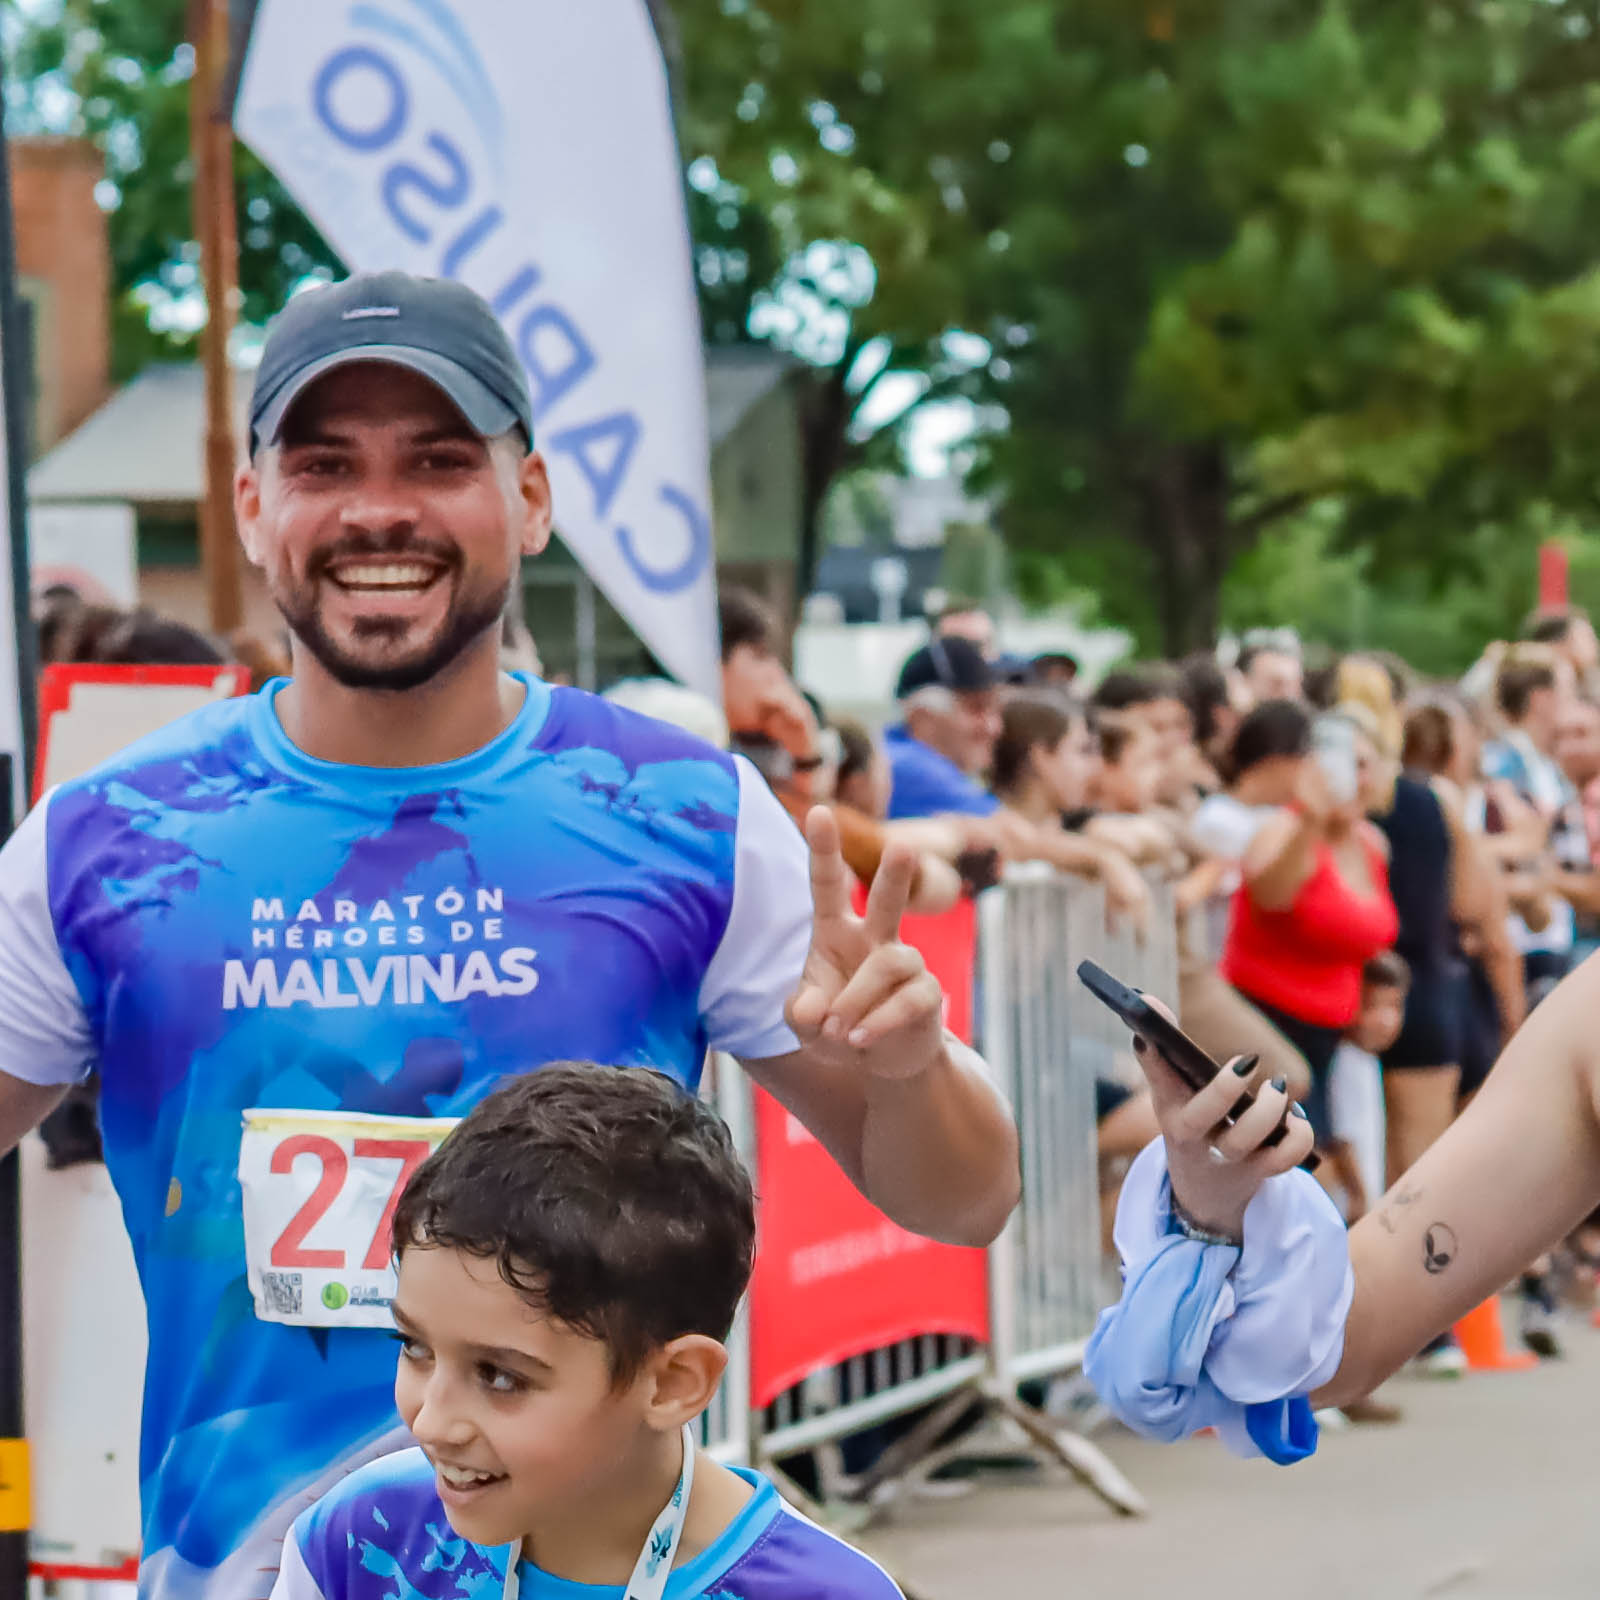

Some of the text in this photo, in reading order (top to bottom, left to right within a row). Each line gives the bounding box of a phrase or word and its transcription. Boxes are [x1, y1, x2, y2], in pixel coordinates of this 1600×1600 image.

[252, 886, 504, 923] MARATÓN
[252, 917, 504, 949] HÉROES DE
[222, 946, 539, 1010] MALVINAS
[270, 1134, 429, 1270] 27
